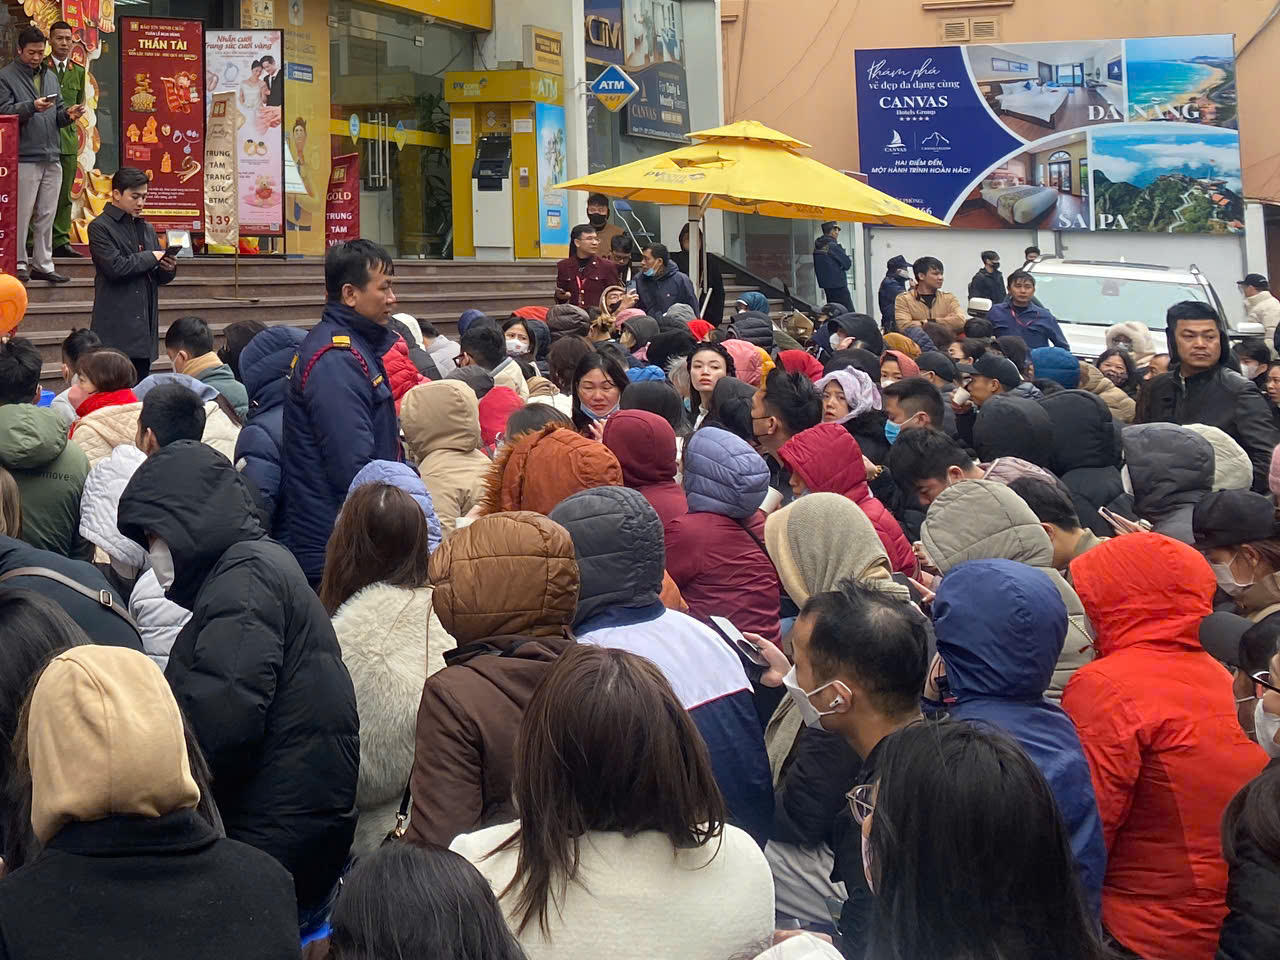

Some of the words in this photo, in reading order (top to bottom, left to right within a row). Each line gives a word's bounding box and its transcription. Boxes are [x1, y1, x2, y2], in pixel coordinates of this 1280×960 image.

[170, 39, 188, 50] TÀI
[910, 57, 941, 82] phá
[599, 81, 625, 90] ATM
[879, 95, 948, 109] CANVAS
[208, 215, 231, 225] 139
[1058, 213, 1088, 229] SA
[1099, 213, 1129, 230] PA
